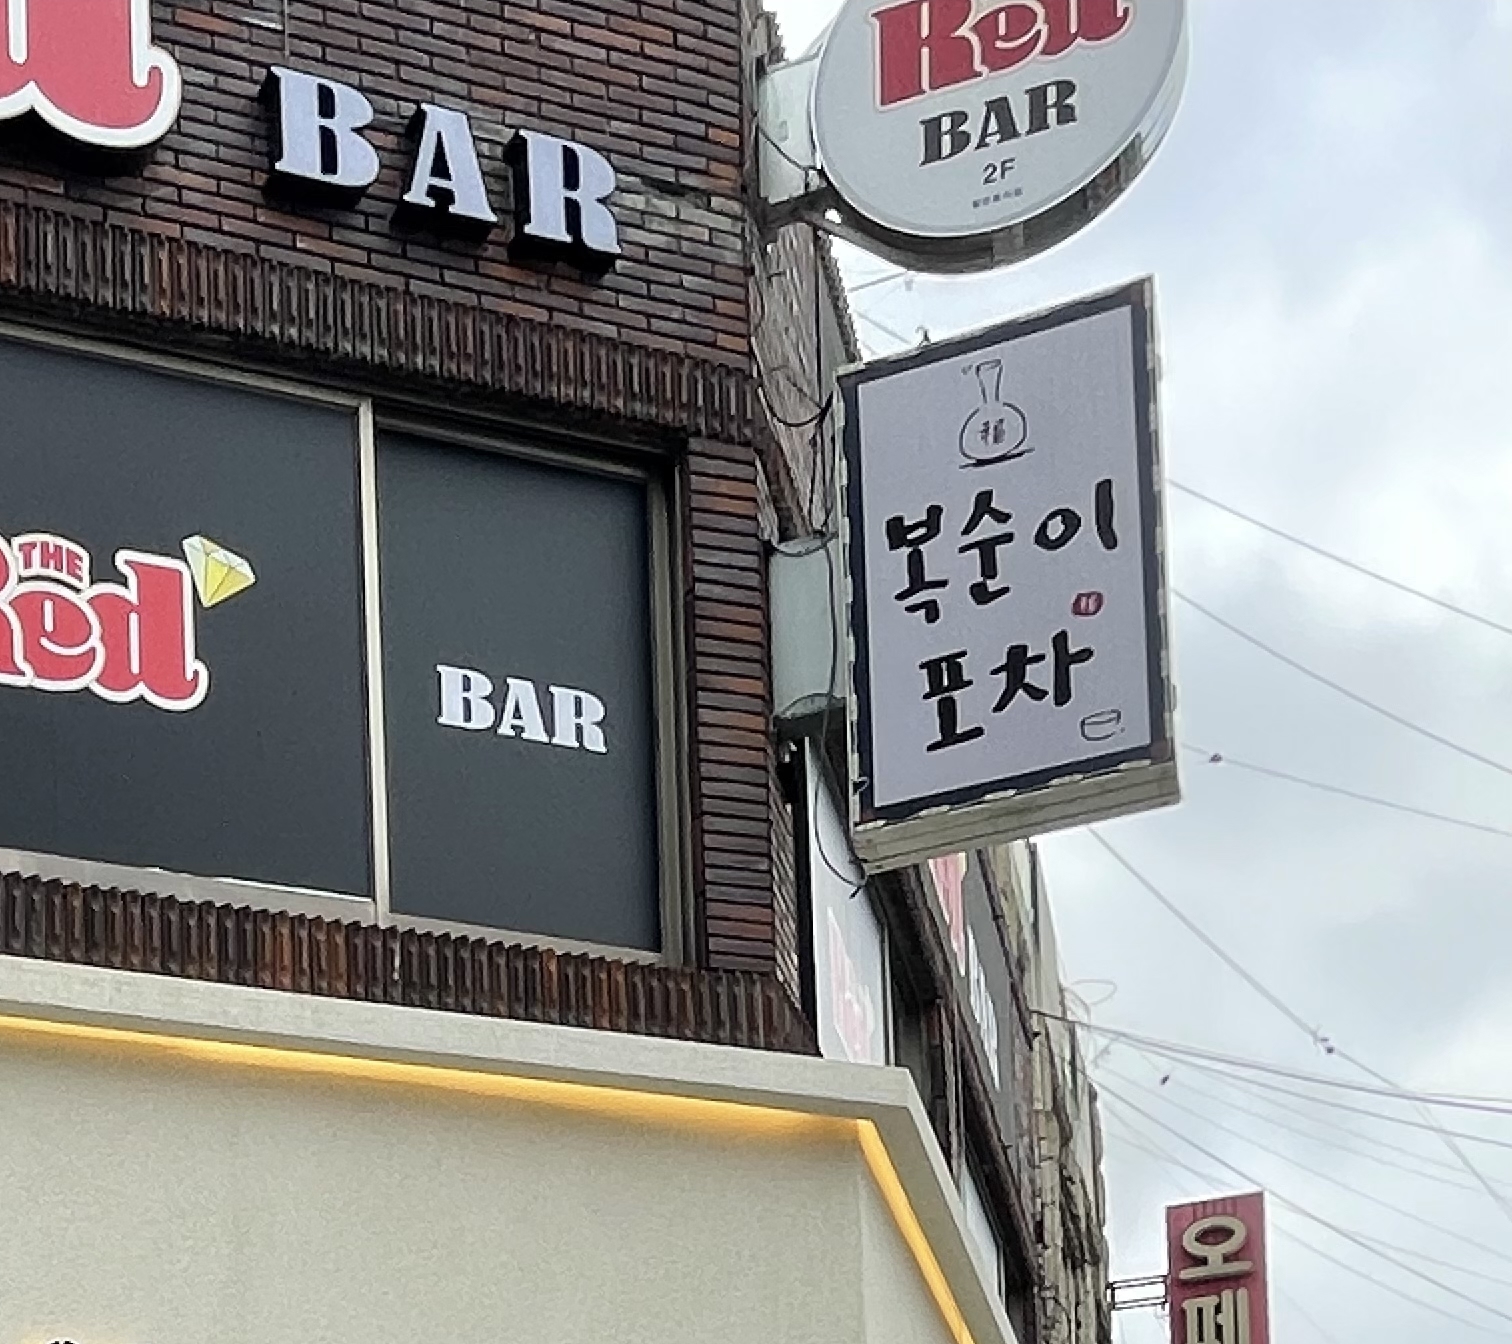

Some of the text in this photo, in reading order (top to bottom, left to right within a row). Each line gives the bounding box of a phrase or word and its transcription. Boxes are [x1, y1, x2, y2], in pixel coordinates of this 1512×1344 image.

[269, 65, 623, 258] BAR
[919, 79, 1078, 167] BAR
[982, 157, 1017, 185] 2F
[18, 538, 86, 581] THE
[885, 478, 1118, 624] 복순이
[436, 663, 609, 756] BAR
[917, 629, 1095, 753] 포차
